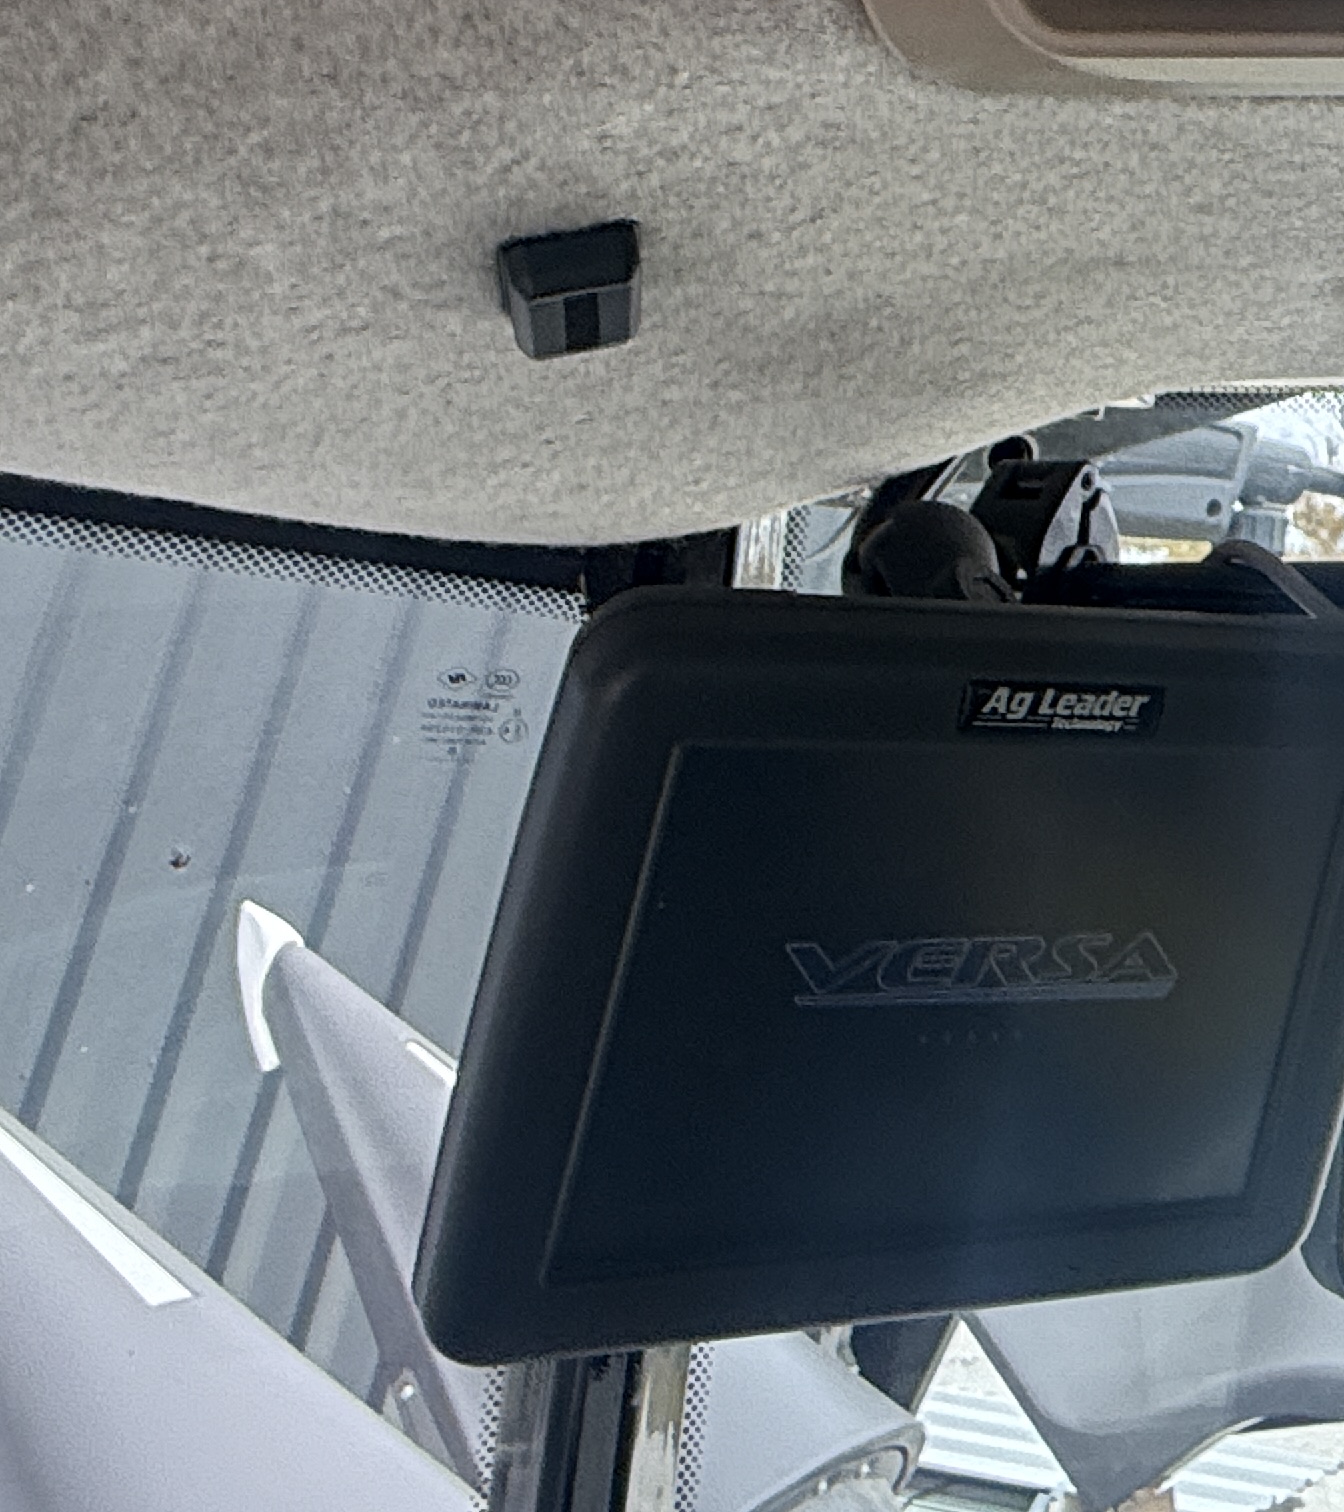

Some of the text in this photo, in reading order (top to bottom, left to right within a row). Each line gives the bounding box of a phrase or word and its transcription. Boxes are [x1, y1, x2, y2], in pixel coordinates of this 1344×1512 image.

[981, 687, 1151, 719] Ag Leader
[786, 931, 1178, 994] VERSA
